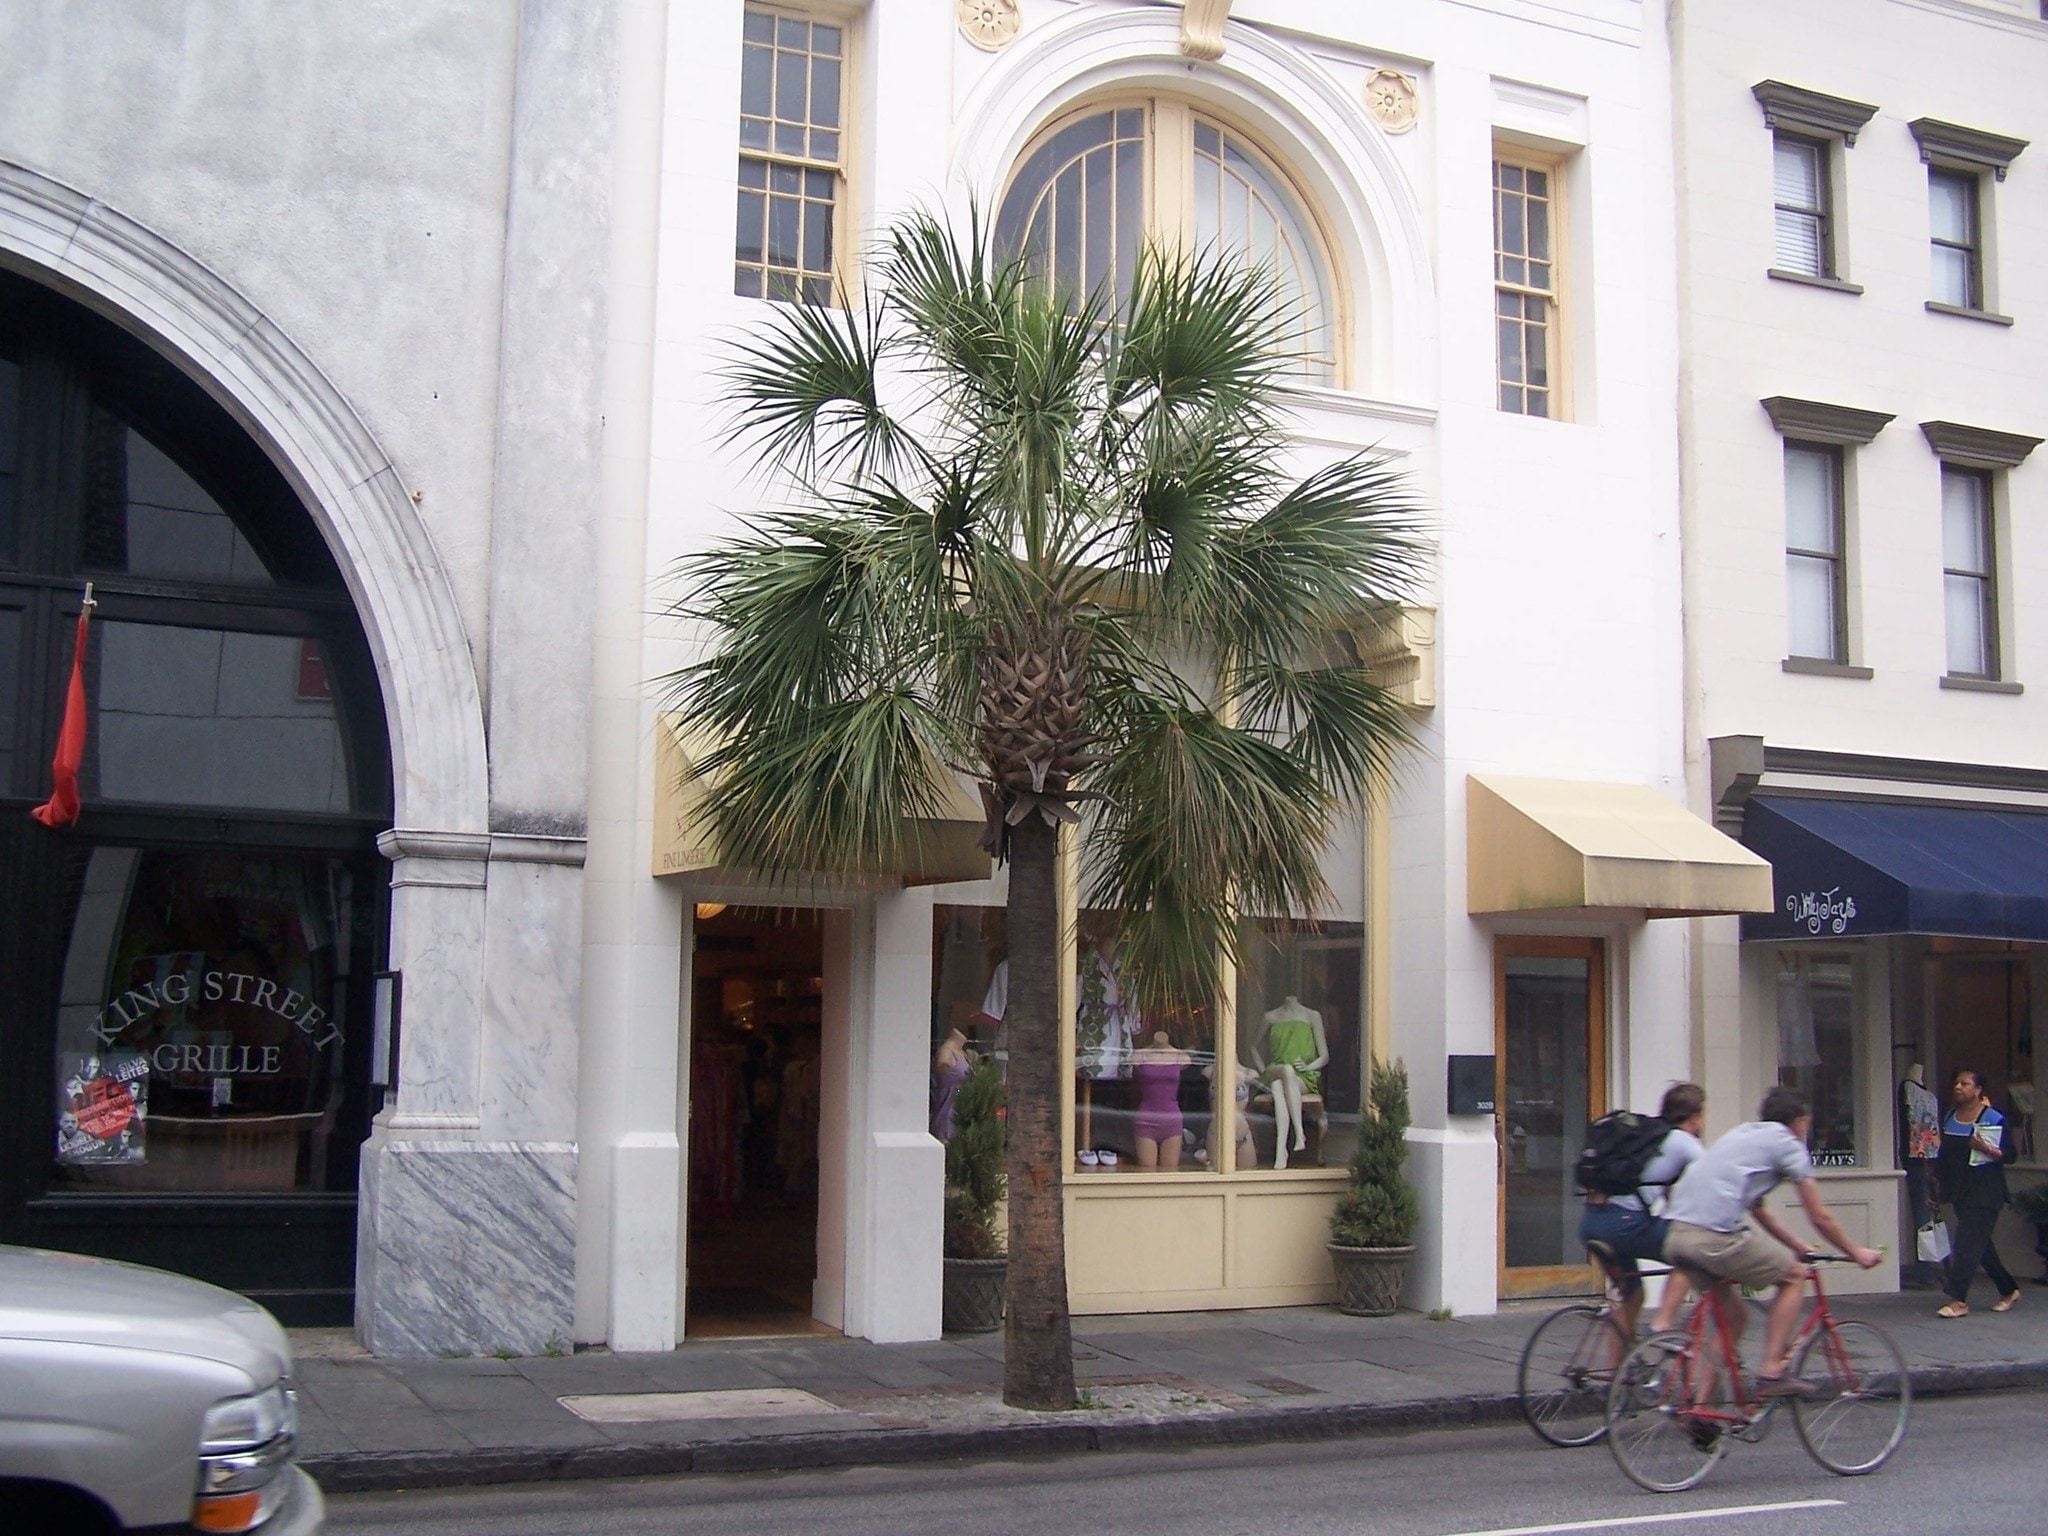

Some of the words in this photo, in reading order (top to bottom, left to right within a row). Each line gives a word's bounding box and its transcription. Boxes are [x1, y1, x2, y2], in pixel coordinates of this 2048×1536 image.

[86, 973, 191, 1047] KING
[204, 971, 346, 1053] STREET
[118, 1056, 147, 1072] SILVA
[153, 1043, 281, 1074] GRILLE
[115, 1064, 150, 1083] LEITES
[1822, 1155, 1855, 1166] JAY'S
